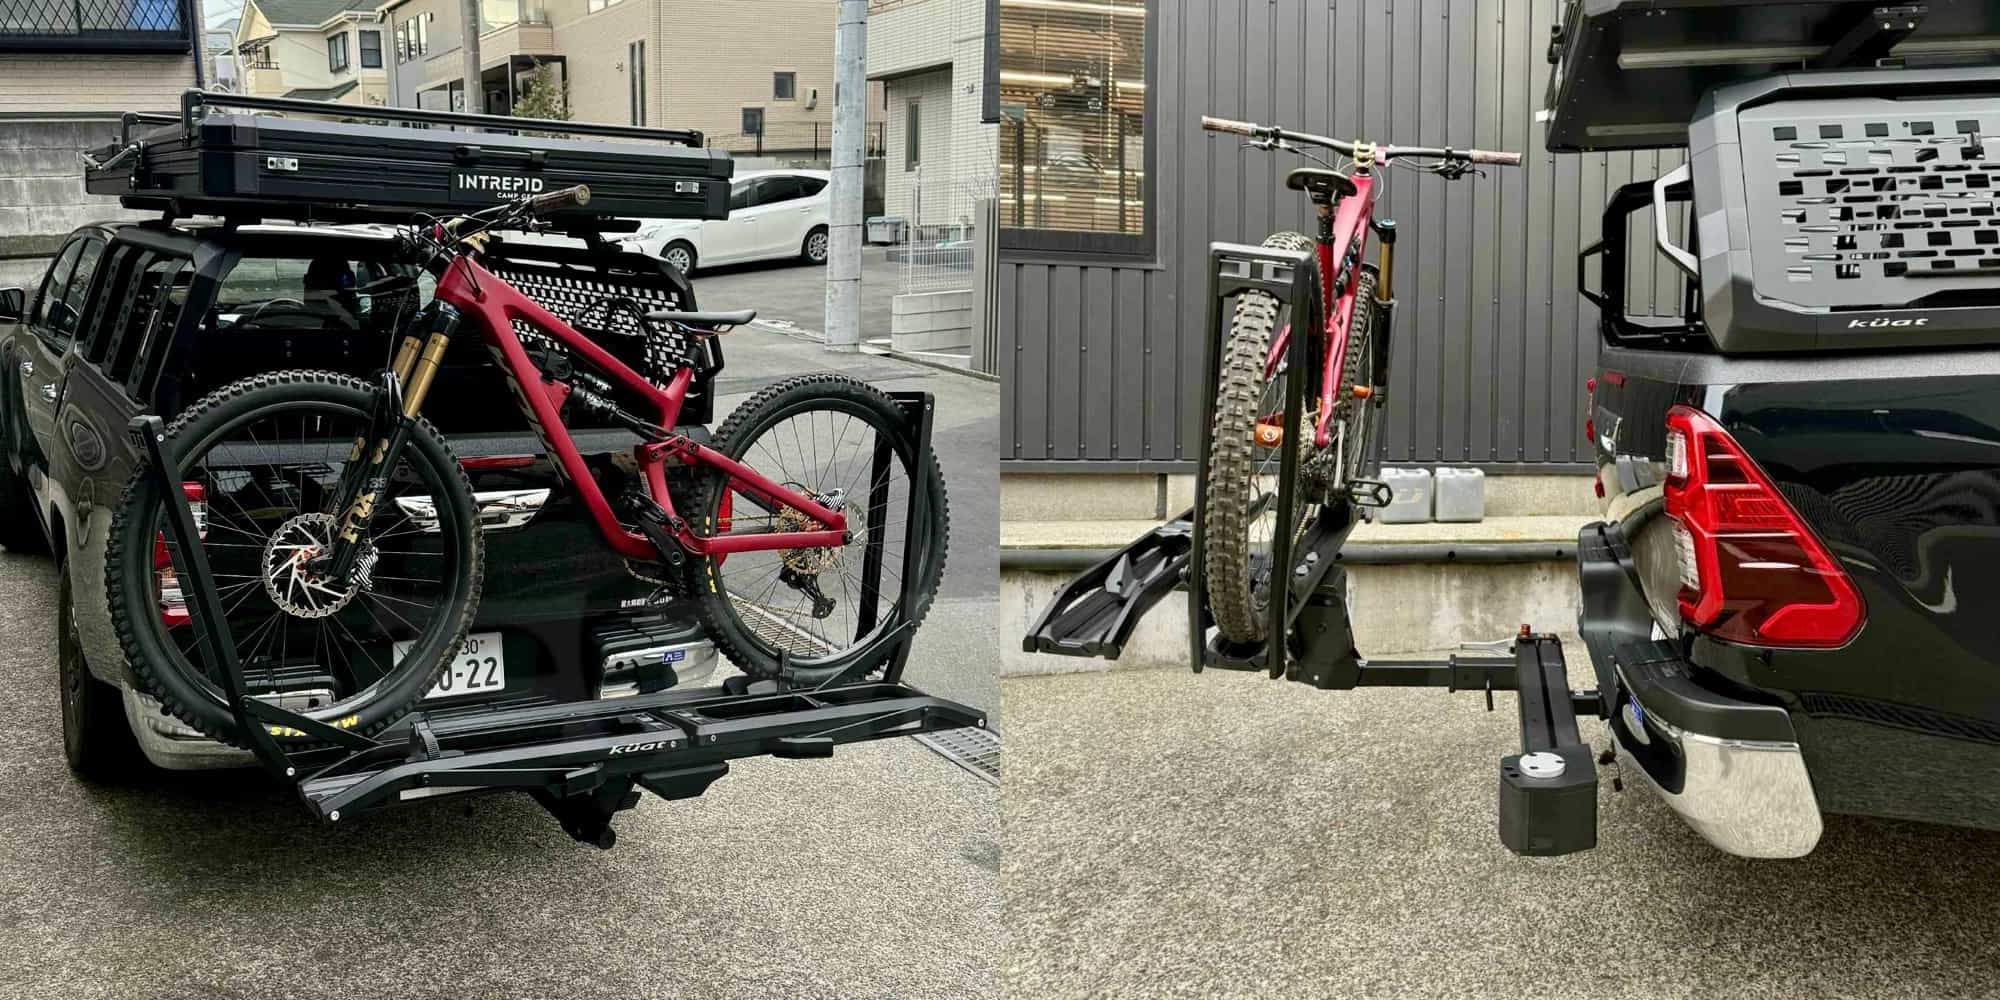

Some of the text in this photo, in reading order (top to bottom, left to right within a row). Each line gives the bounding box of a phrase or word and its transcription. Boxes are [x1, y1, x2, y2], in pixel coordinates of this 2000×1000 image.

[458, 173, 543, 192] INTREPID
[462, 639, 479, 655] 30
[440, 656, 499, 692] 0-22
